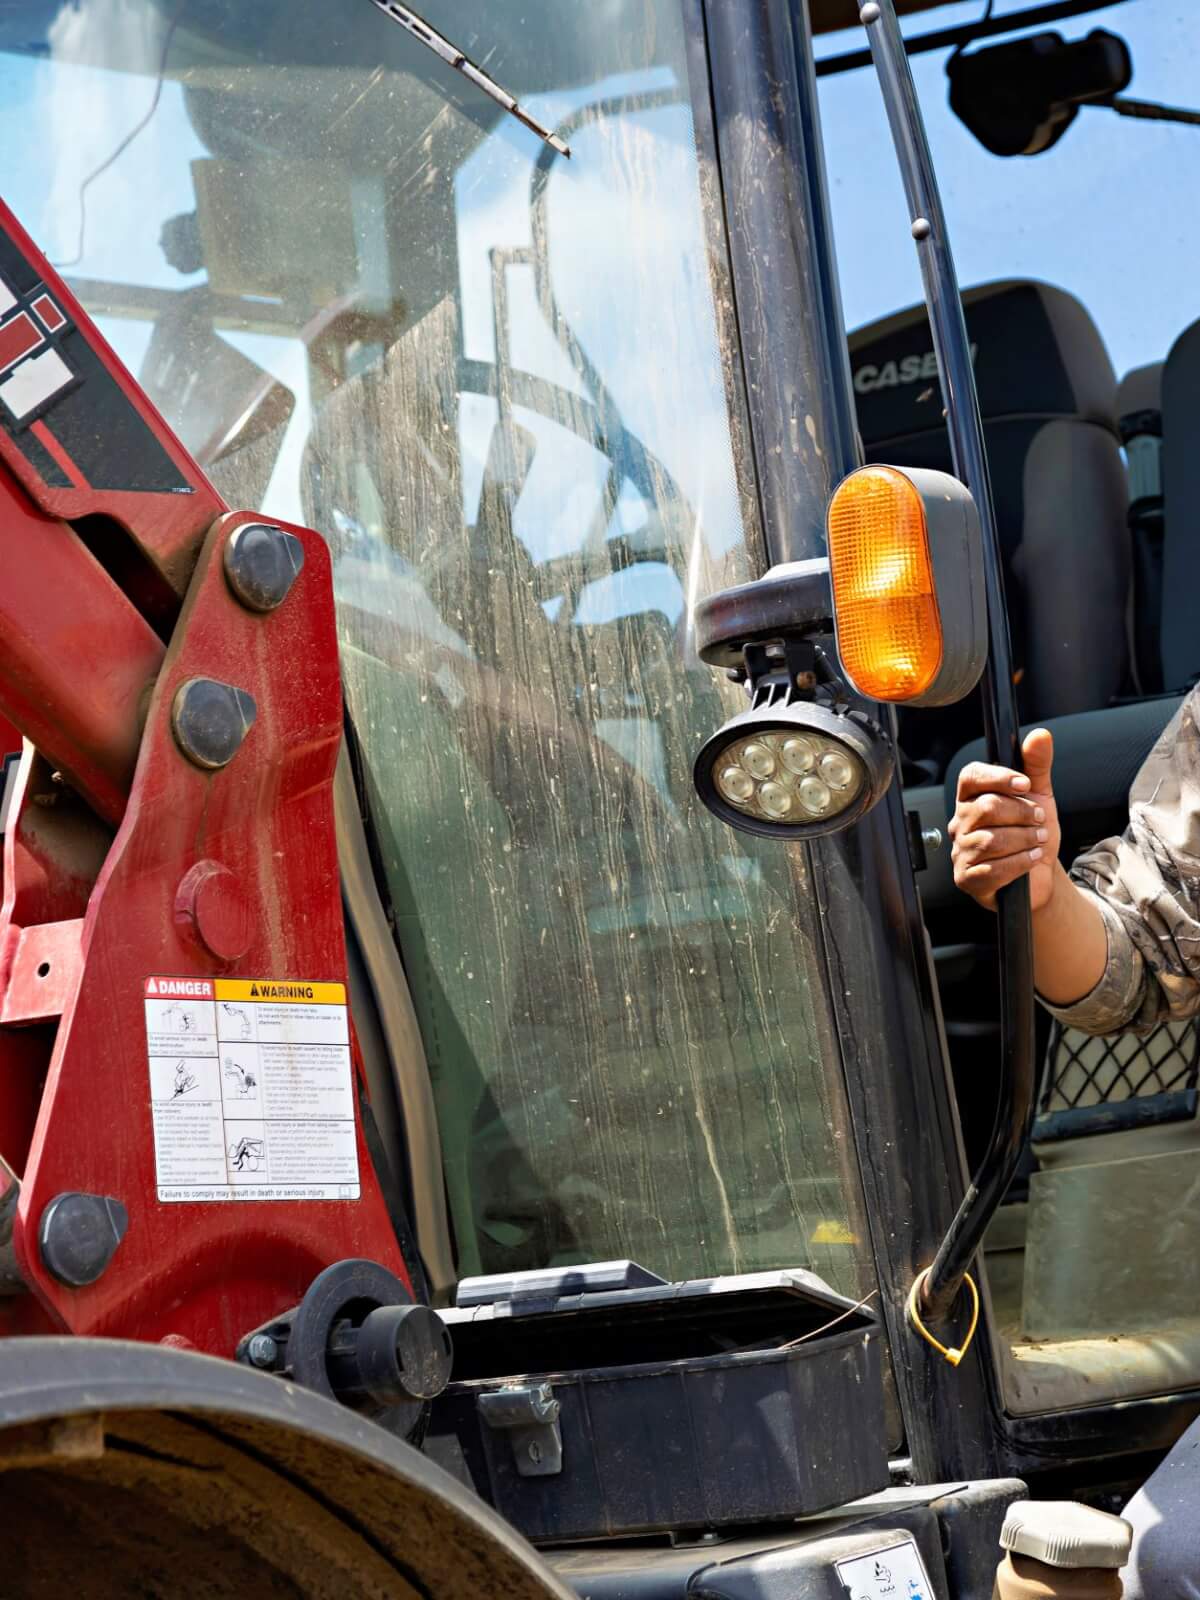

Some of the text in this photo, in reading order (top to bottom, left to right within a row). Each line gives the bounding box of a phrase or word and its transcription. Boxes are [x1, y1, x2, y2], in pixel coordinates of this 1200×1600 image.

[159, 980, 211, 996] DANGER
[260, 985, 314, 999] WARNING
[160, 1189, 182, 1198] Failure
[183, 1190, 190, 1198] to
[191, 1190, 215, 1200] comply
[215, 1190, 230, 1199] may
[257, 1188, 274, 1197] death
